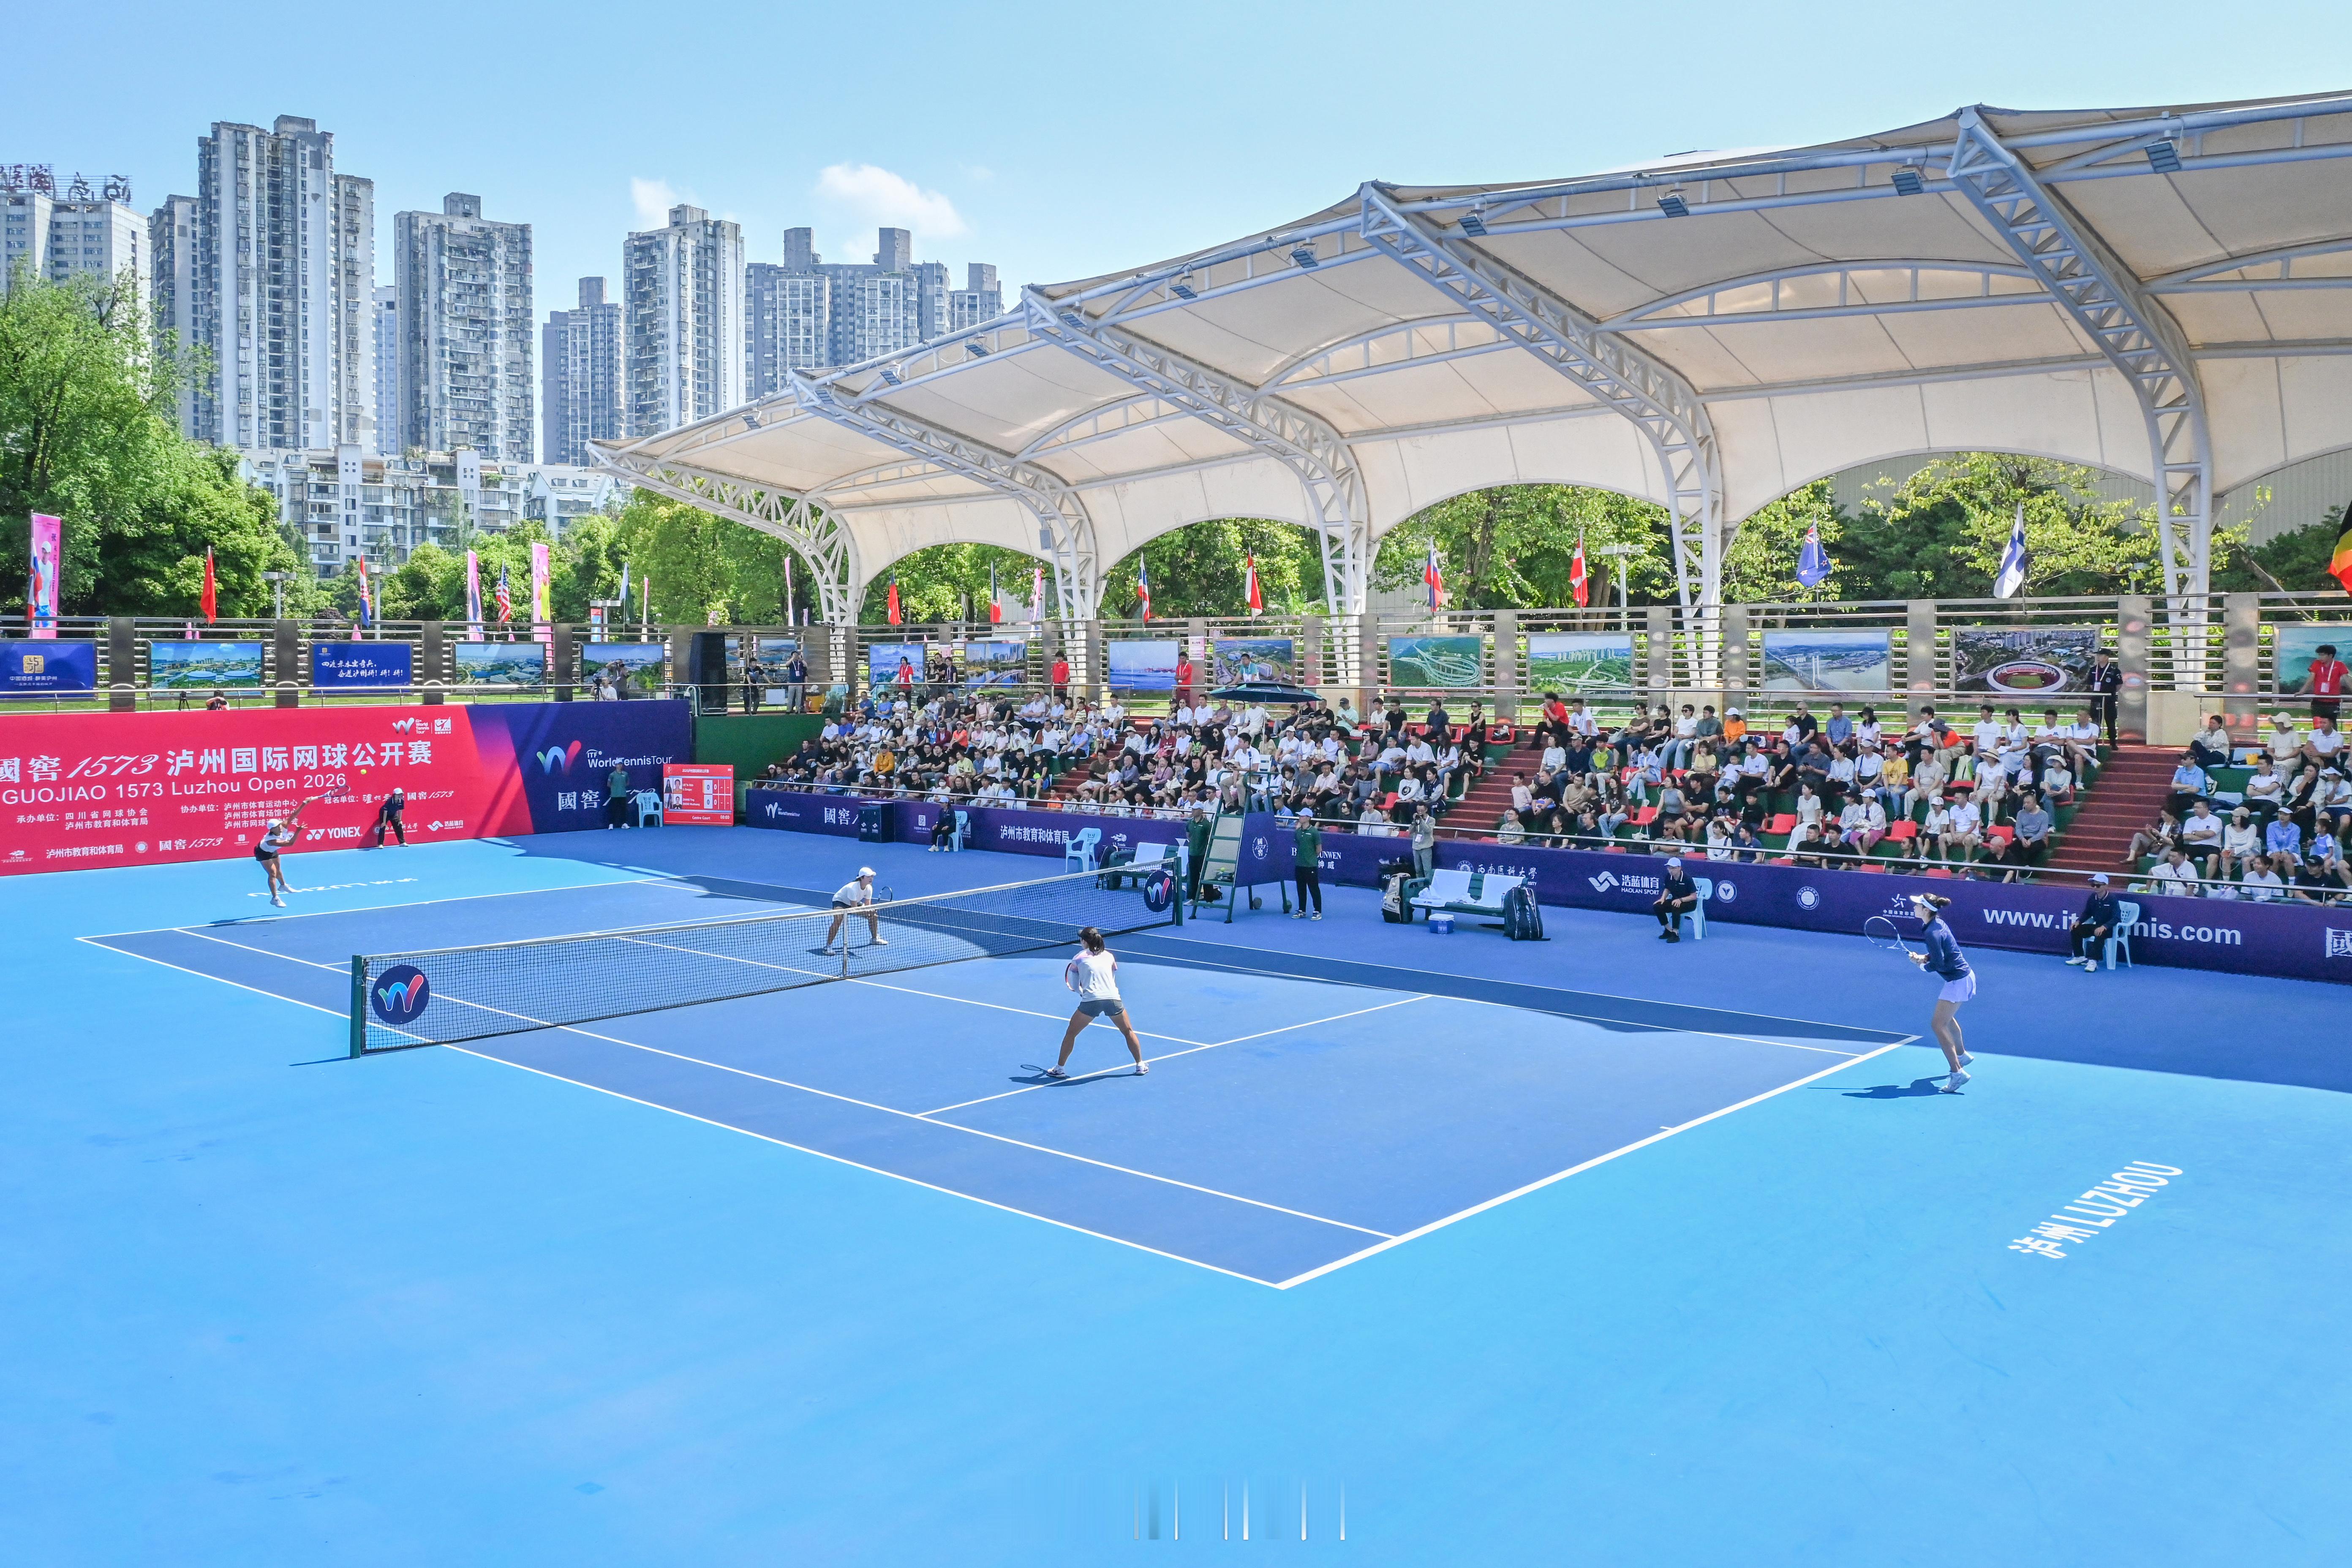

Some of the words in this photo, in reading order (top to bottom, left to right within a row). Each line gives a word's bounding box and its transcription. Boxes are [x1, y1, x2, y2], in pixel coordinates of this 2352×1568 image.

[66, 754, 159, 779] 1573
[166, 740, 432, 776] 泸州国际网球公开赛
[2, 785, 106, 804] GUOJIAO
[116, 782, 163, 798] 1573
[172, 780, 240, 795] Luzhou
[248, 777, 296, 793] Open
[303, 773, 346, 788] 2026
[180, 803, 219, 814] 协办单位：
[224, 799, 298, 811] 泸州市体育运动中心
[558, 789, 601, 811] 國窖
[16, 813, 60, 824] 承办单位：
[65, 807, 148, 820] 四川省网球协会
[65, 817, 148, 830] 泸州市教育和体育局
[824, 807, 851, 825] 國窖
[327, 826, 361, 839] YONEX
[1000, 825, 1070, 845] 泸州市教育和体育局
[46, 844, 124, 859] 泸州市教育和体育局
[159, 838, 187, 852] 國窖
[188, 837, 223, 848] 1573
[1622, 874, 1660, 889] 浩蓝体育
[2050, 1160, 2183, 1228] LUZHOU
[2007, 1221, 2099, 1259] 泸州
